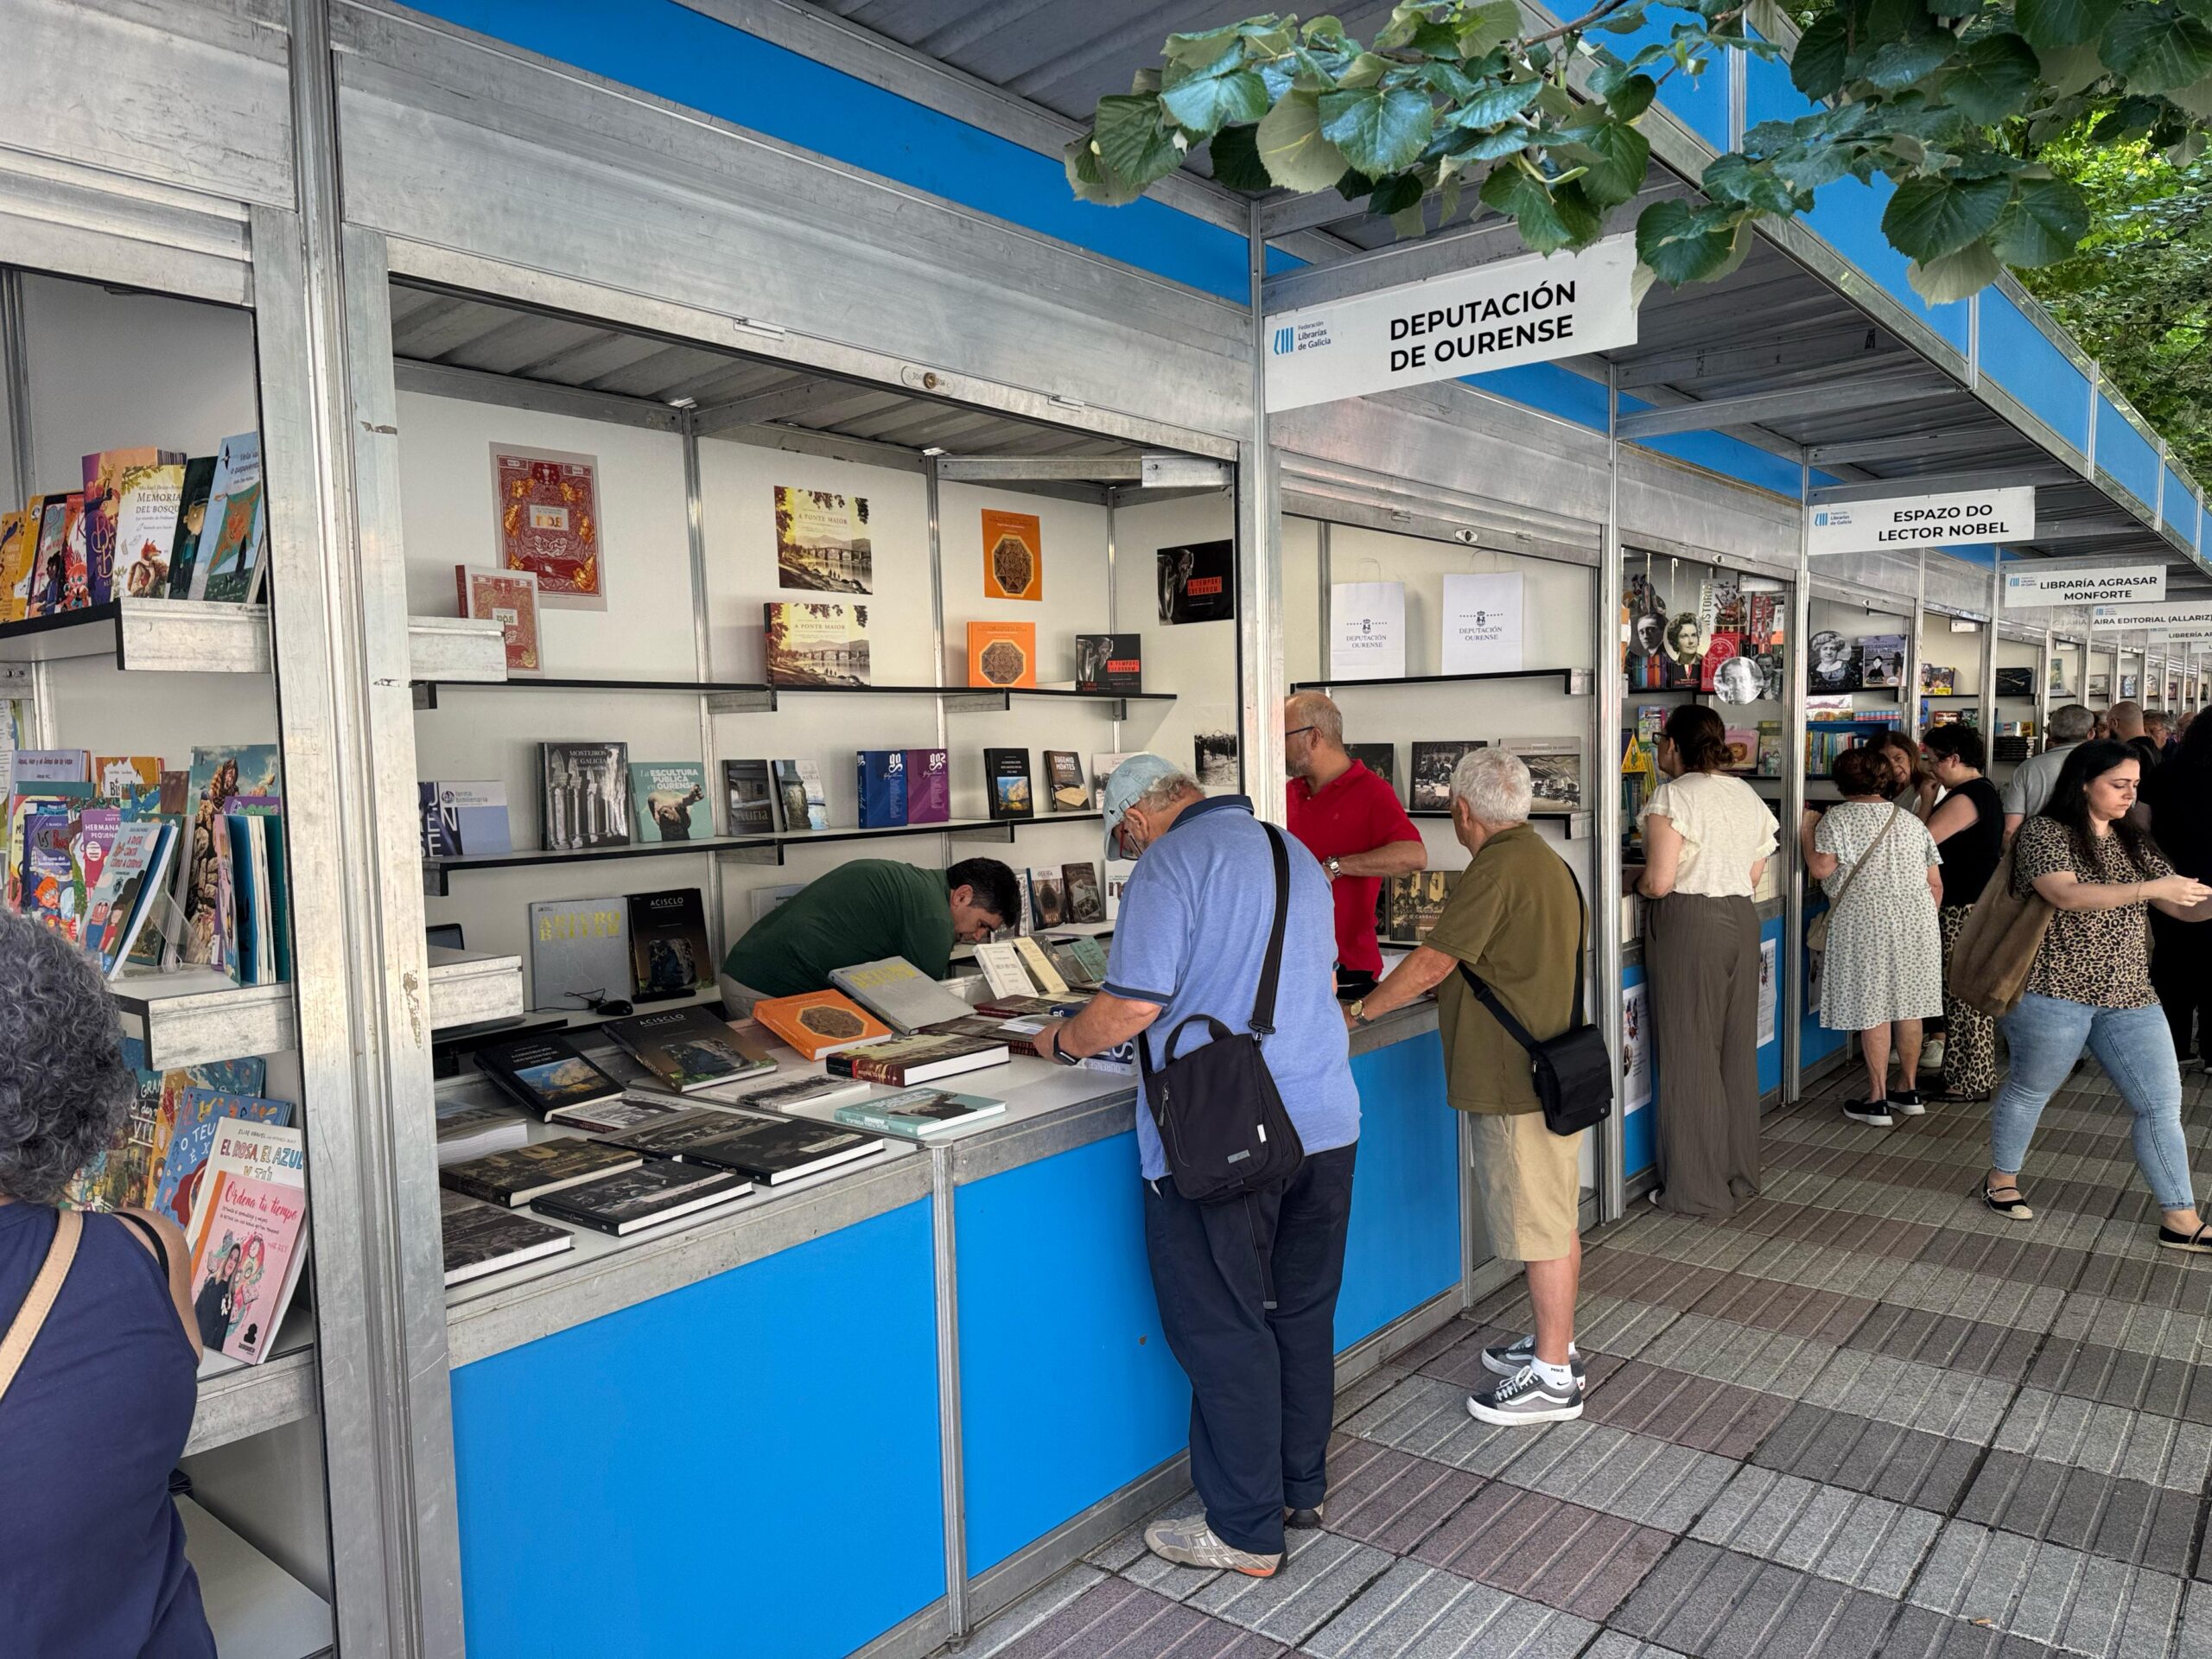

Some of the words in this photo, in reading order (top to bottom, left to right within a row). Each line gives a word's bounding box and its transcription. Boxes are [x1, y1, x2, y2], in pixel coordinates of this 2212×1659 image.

[1390, 279, 1576, 341] DEPUTACIÓN
[1307, 337, 1332, 348] Galicia
[1390, 345, 1426, 372] DE
[1434, 314, 1573, 362] OURENSE
[136, 505, 151, 514] DEL
[1893, 506, 1961, 523] ESPAZO
[1966, 504, 1993, 517] DO
[804, 513, 825, 522] PONTE
[827, 516, 848, 525] MAIOR
[1878, 526, 1943, 542] LECTOR
[1948, 521, 2009, 537] NOBEL
[2040, 577, 2095, 590] LIBRARÍA
[2098, 576, 2158, 588] AGRASAR
[2063, 590, 2132, 601] MONFORTE
[650, 768, 699, 777] ESCULTURA
[650, 897, 683, 906] ACISCLO
[639, 1013, 685, 1027] ACISCLO
[180, 1139, 188, 1151] O
[220, 1138, 232, 1156] EL
[232, 1140, 258, 1163] ROSA,
[260, 1145, 272, 1164] EL
[272, 1147, 302, 1170] AZUL
[225, 1180, 257, 1208] Ordena
[258, 1195, 268, 1212] tu
[271, 1195, 298, 1224] tiempo
